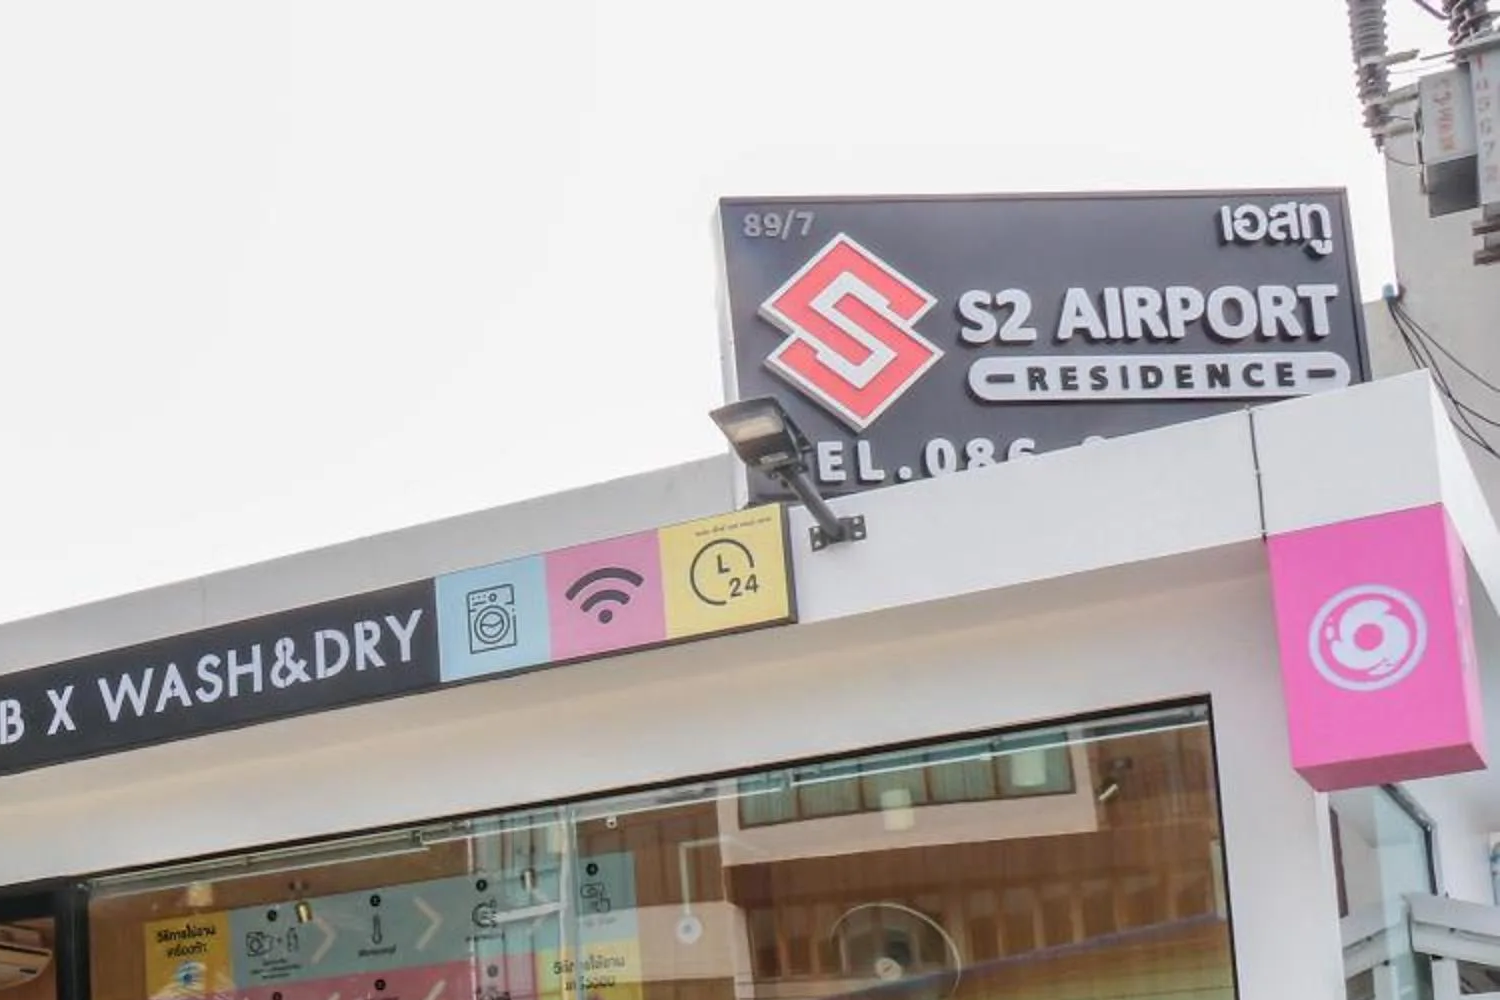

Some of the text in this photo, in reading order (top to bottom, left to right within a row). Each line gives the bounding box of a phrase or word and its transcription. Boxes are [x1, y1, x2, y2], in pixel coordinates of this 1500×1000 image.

[742, 211, 813, 239] 89/7
[1219, 202, 1334, 254] เอสทู
[957, 283, 1339, 344] S2 AIRPORT
[1026, 360, 1296, 392] RESIDENCE
[728, 574, 761, 598] 24
[46, 685, 77, 736] X
[98, 608, 423, 722] WASH&DRY
